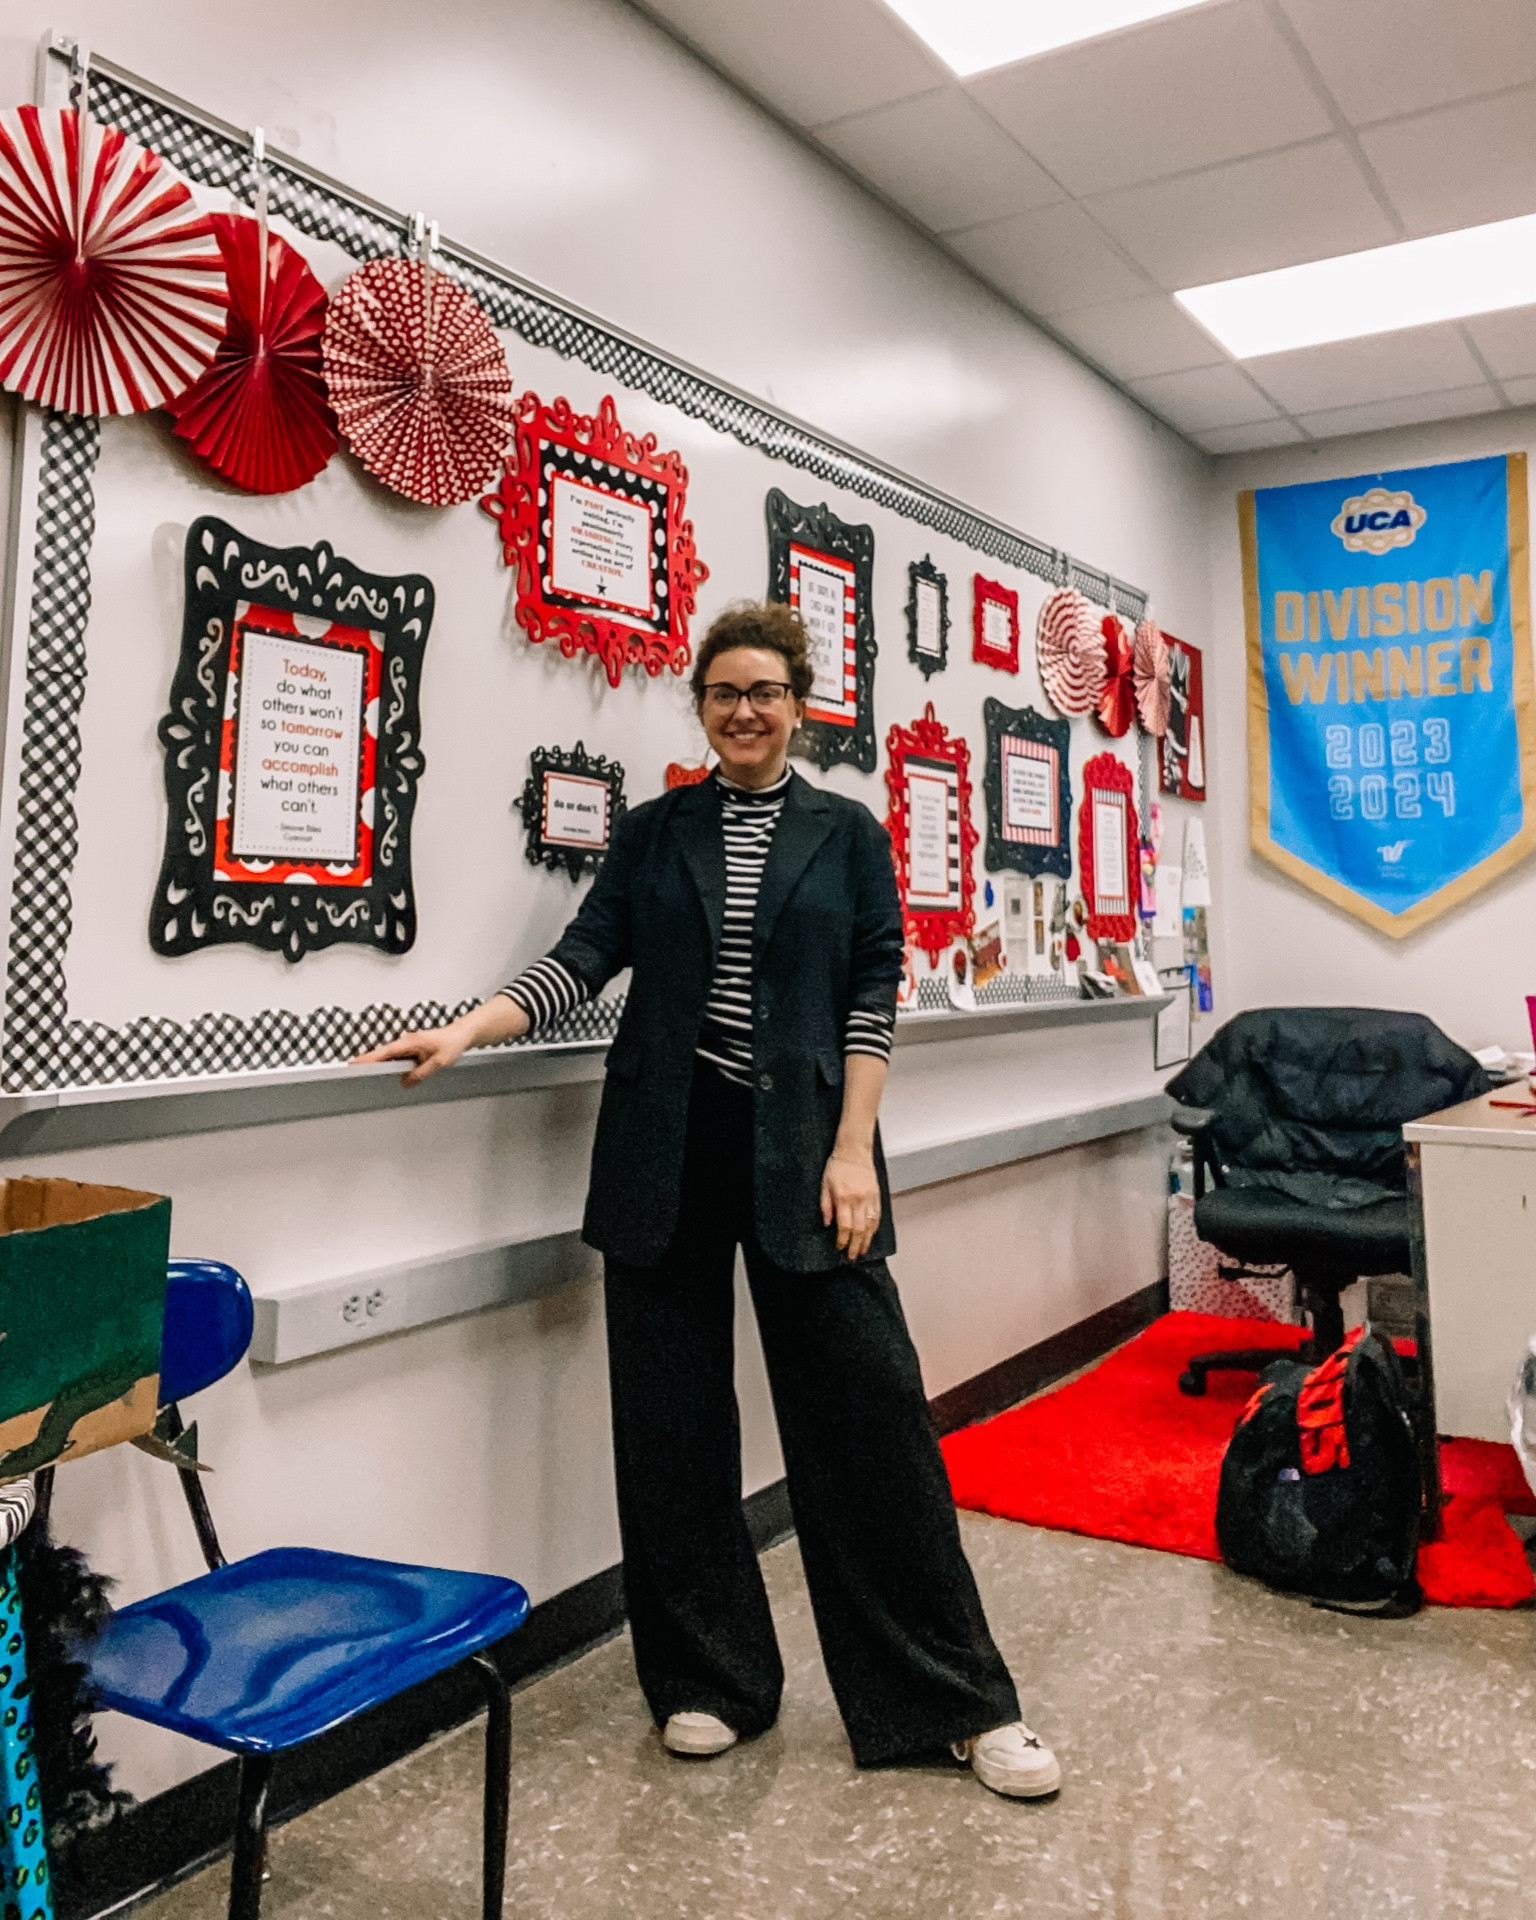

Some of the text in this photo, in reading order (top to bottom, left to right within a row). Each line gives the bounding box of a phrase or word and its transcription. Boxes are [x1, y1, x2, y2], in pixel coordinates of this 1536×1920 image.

[1344, 510, 1412, 534] UCA
[1275, 570, 1494, 643] DIVISION
[283, 658, 327, 682] Today,
[1279, 637, 1493, 706] WINNER
[276, 679, 332, 700] do what
[262, 698, 343, 720] others won't
[261, 719, 343, 739] so tomorrow
[274, 741, 329, 756] you can
[1326, 717, 1451, 769] 2023
[262, 759, 339, 777] accomplish
[260, 775, 338, 796] what others
[1327, 771, 1456, 821] 2024
[281, 799, 317, 814] can't.
